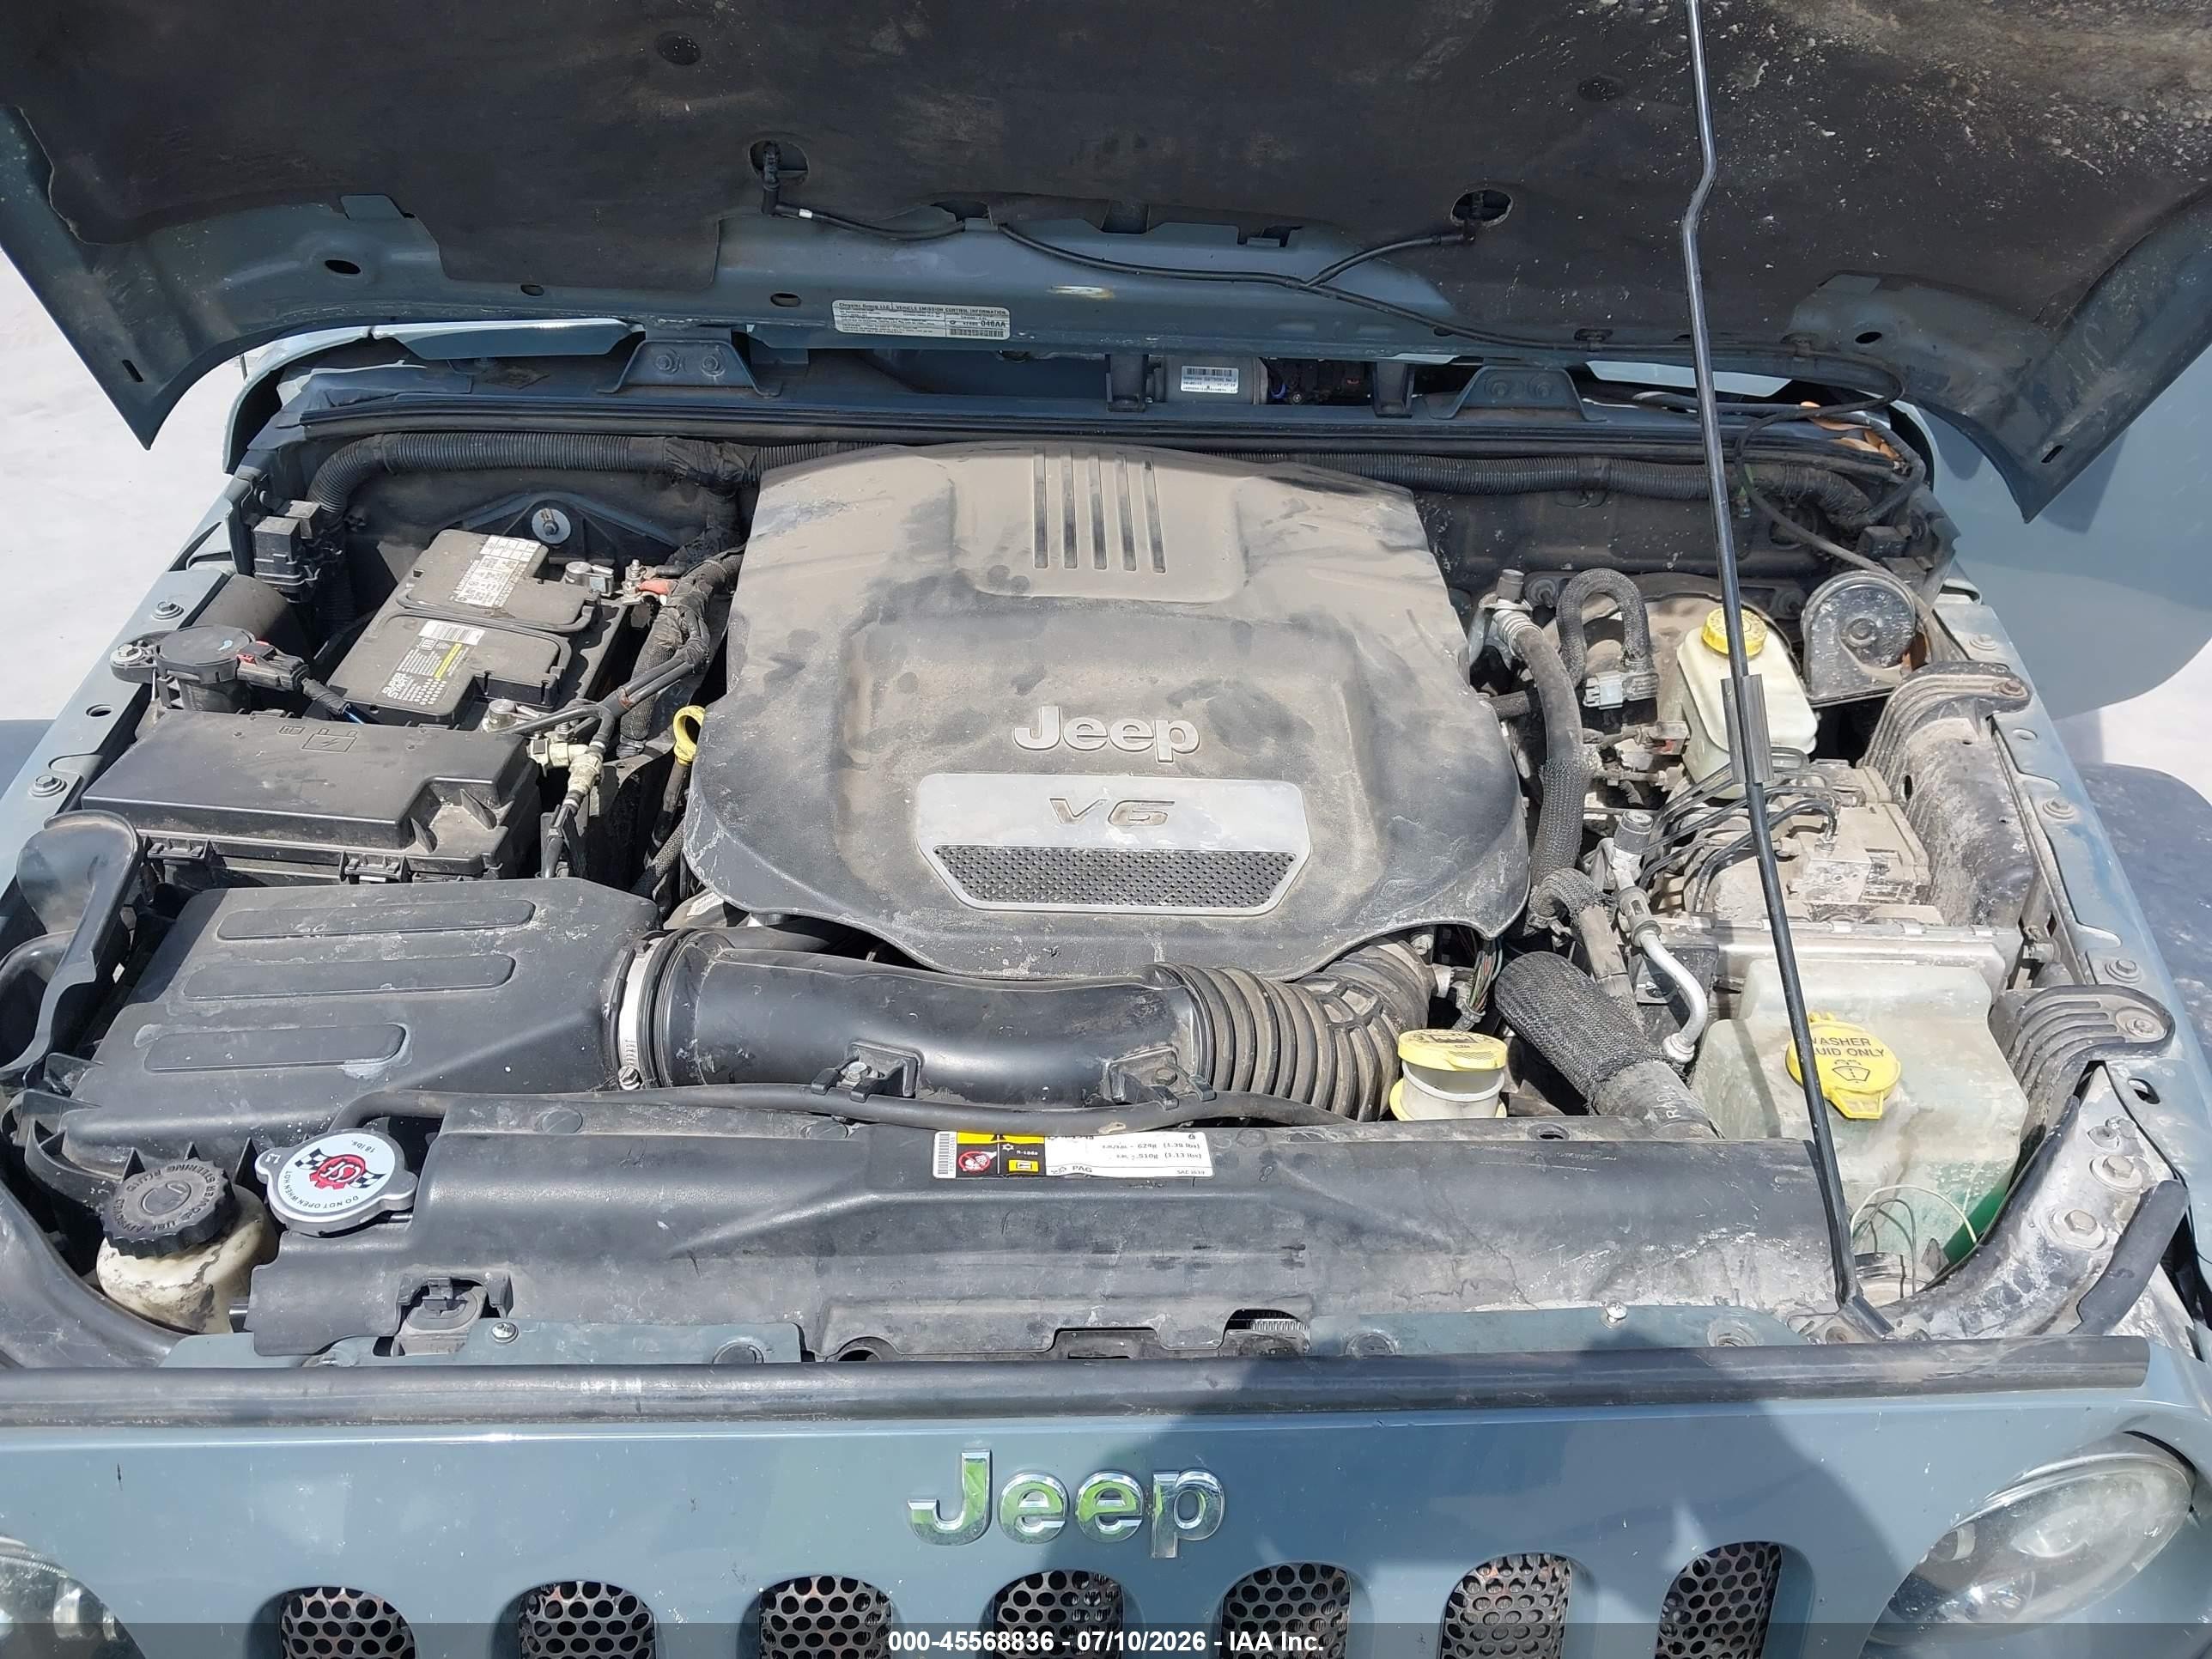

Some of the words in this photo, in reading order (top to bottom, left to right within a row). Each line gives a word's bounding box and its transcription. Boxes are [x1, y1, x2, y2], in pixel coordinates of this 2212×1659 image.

[381, 672, 406, 694] SUPER
[387, 674, 413, 699] START
[1013, 706, 1200, 763] Jeep
[1049, 798, 1176, 826] V6
[1814, 1048, 1842, 1056] UID
[1846, 1048, 1885, 1057] ONLY
[365, 1144, 376, 1154] 18
[165, 1164, 216, 1183] STEERING
[282, 1170, 293, 1186] HOT
[319, 1161, 362, 1183] CSF
[179, 1184, 217, 1222] POWER
[283, 1183, 299, 1201] WHEN
[346, 1195, 360, 1205] DO
[112, 1197, 145, 1233] APPROVED
[296, 1199, 321, 1209] OPEN
[907, 1448, 1225, 1559] Jeep
